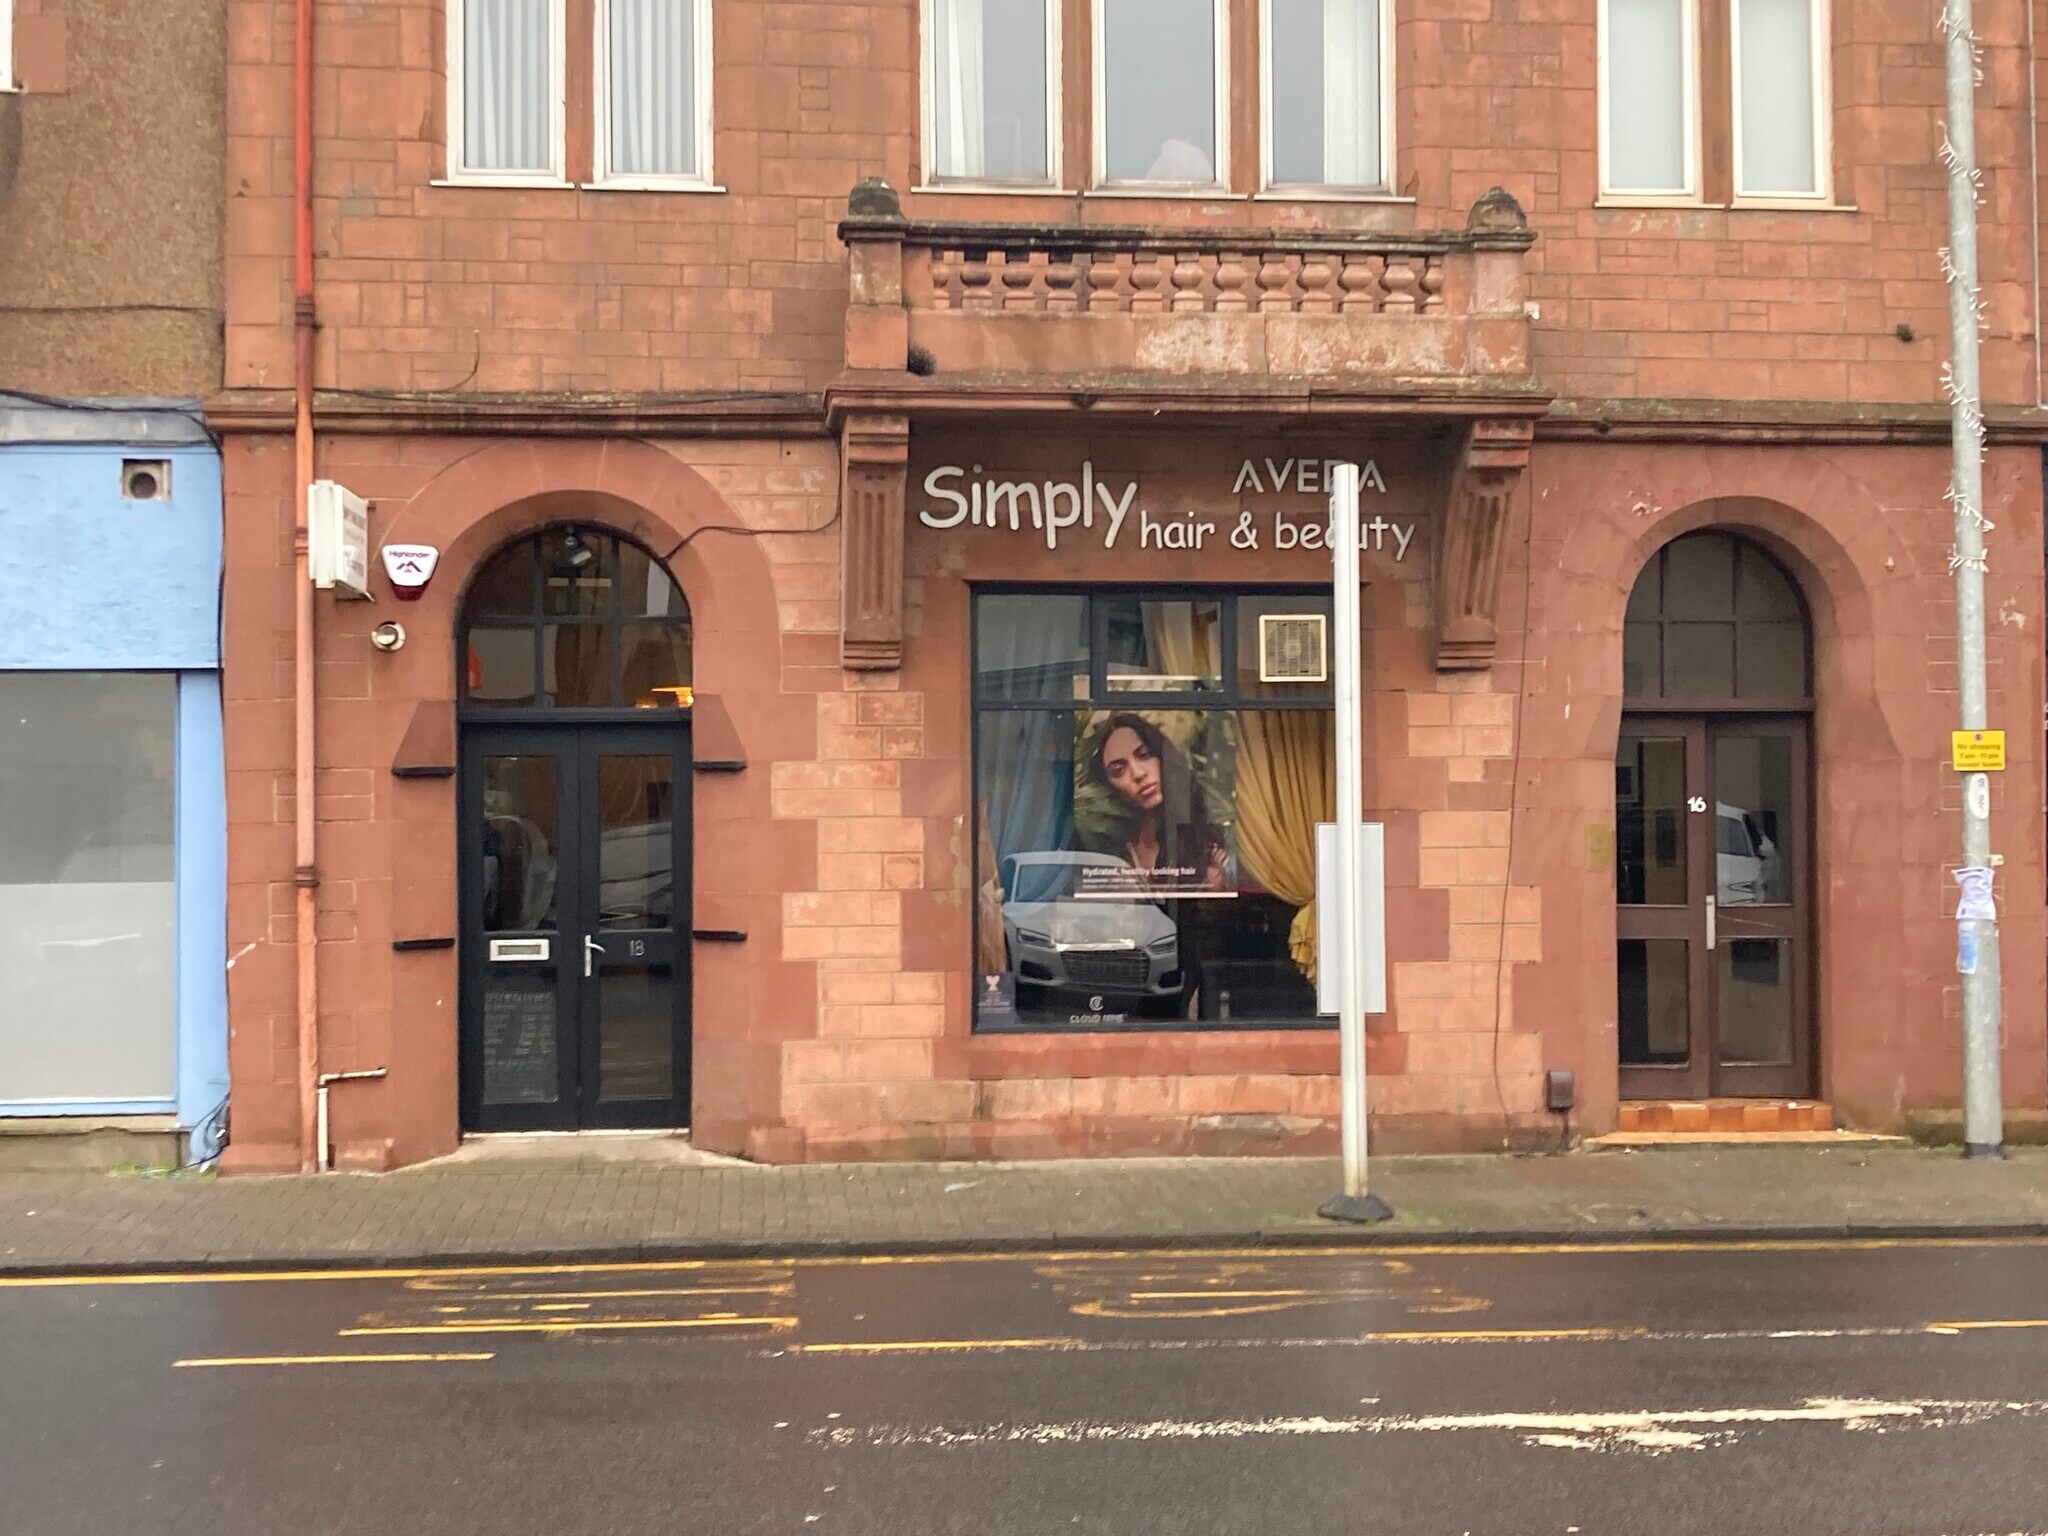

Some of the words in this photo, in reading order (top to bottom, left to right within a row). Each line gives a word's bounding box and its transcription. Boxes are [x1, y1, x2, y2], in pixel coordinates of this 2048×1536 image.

[919, 460, 1138, 549] Simply
[1140, 510, 1216, 549] hair
[1230, 510, 1259, 550] &
[389, 550, 430, 559] Highlander
[1687, 796, 1707, 813] 16
[1151, 866, 1180, 877] looking
[1180, 866, 1196, 876] hair
[629, 939, 645, 956] 18
